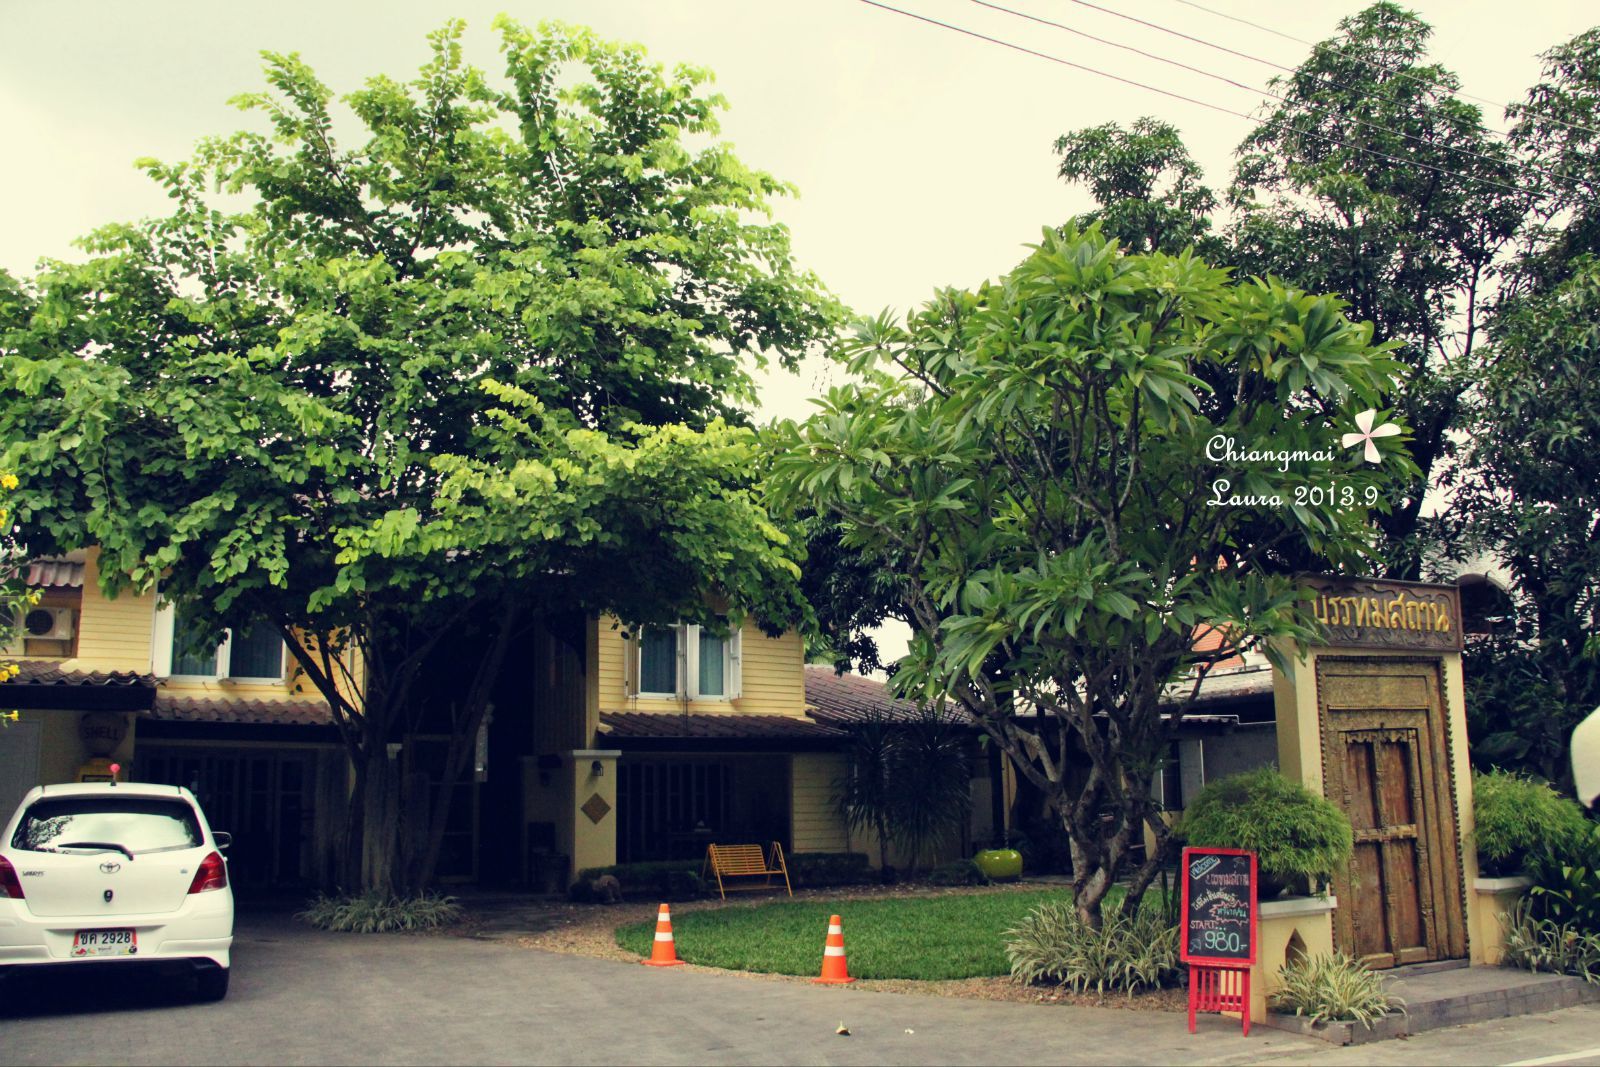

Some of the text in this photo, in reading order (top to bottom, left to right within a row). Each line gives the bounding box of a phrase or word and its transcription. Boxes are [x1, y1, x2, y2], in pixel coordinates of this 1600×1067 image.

[1312, 593, 1451, 632] บรรทมสถาน
[85, 726, 119, 741] SHELL
[102, 932, 131, 944] 2928
